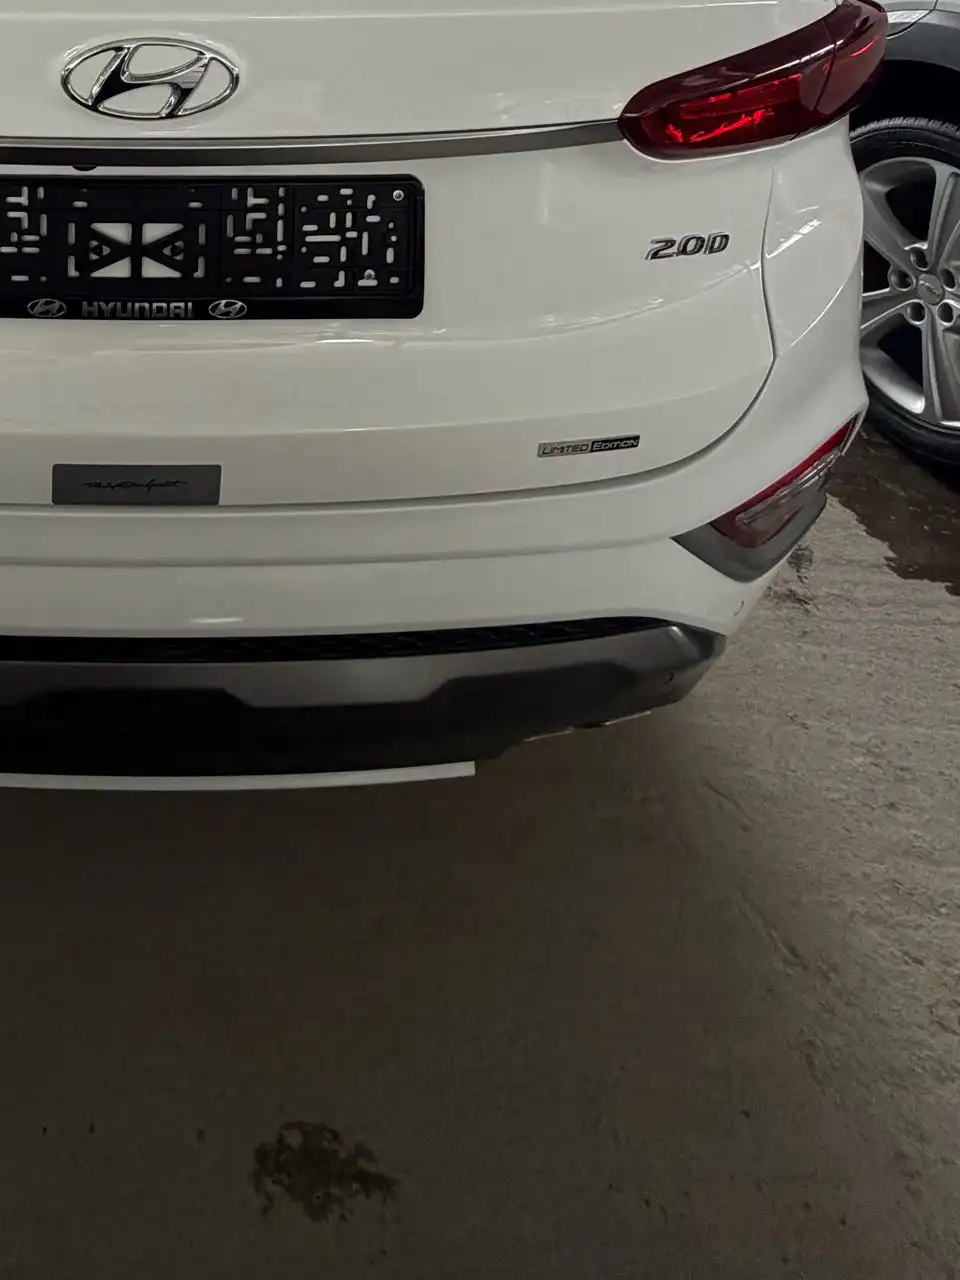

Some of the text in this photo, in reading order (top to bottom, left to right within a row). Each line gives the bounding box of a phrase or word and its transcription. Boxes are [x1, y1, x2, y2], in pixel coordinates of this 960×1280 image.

[81, 300, 194, 319] HYUNDAI
[541, 438, 639, 456] LIMITED EDITION
